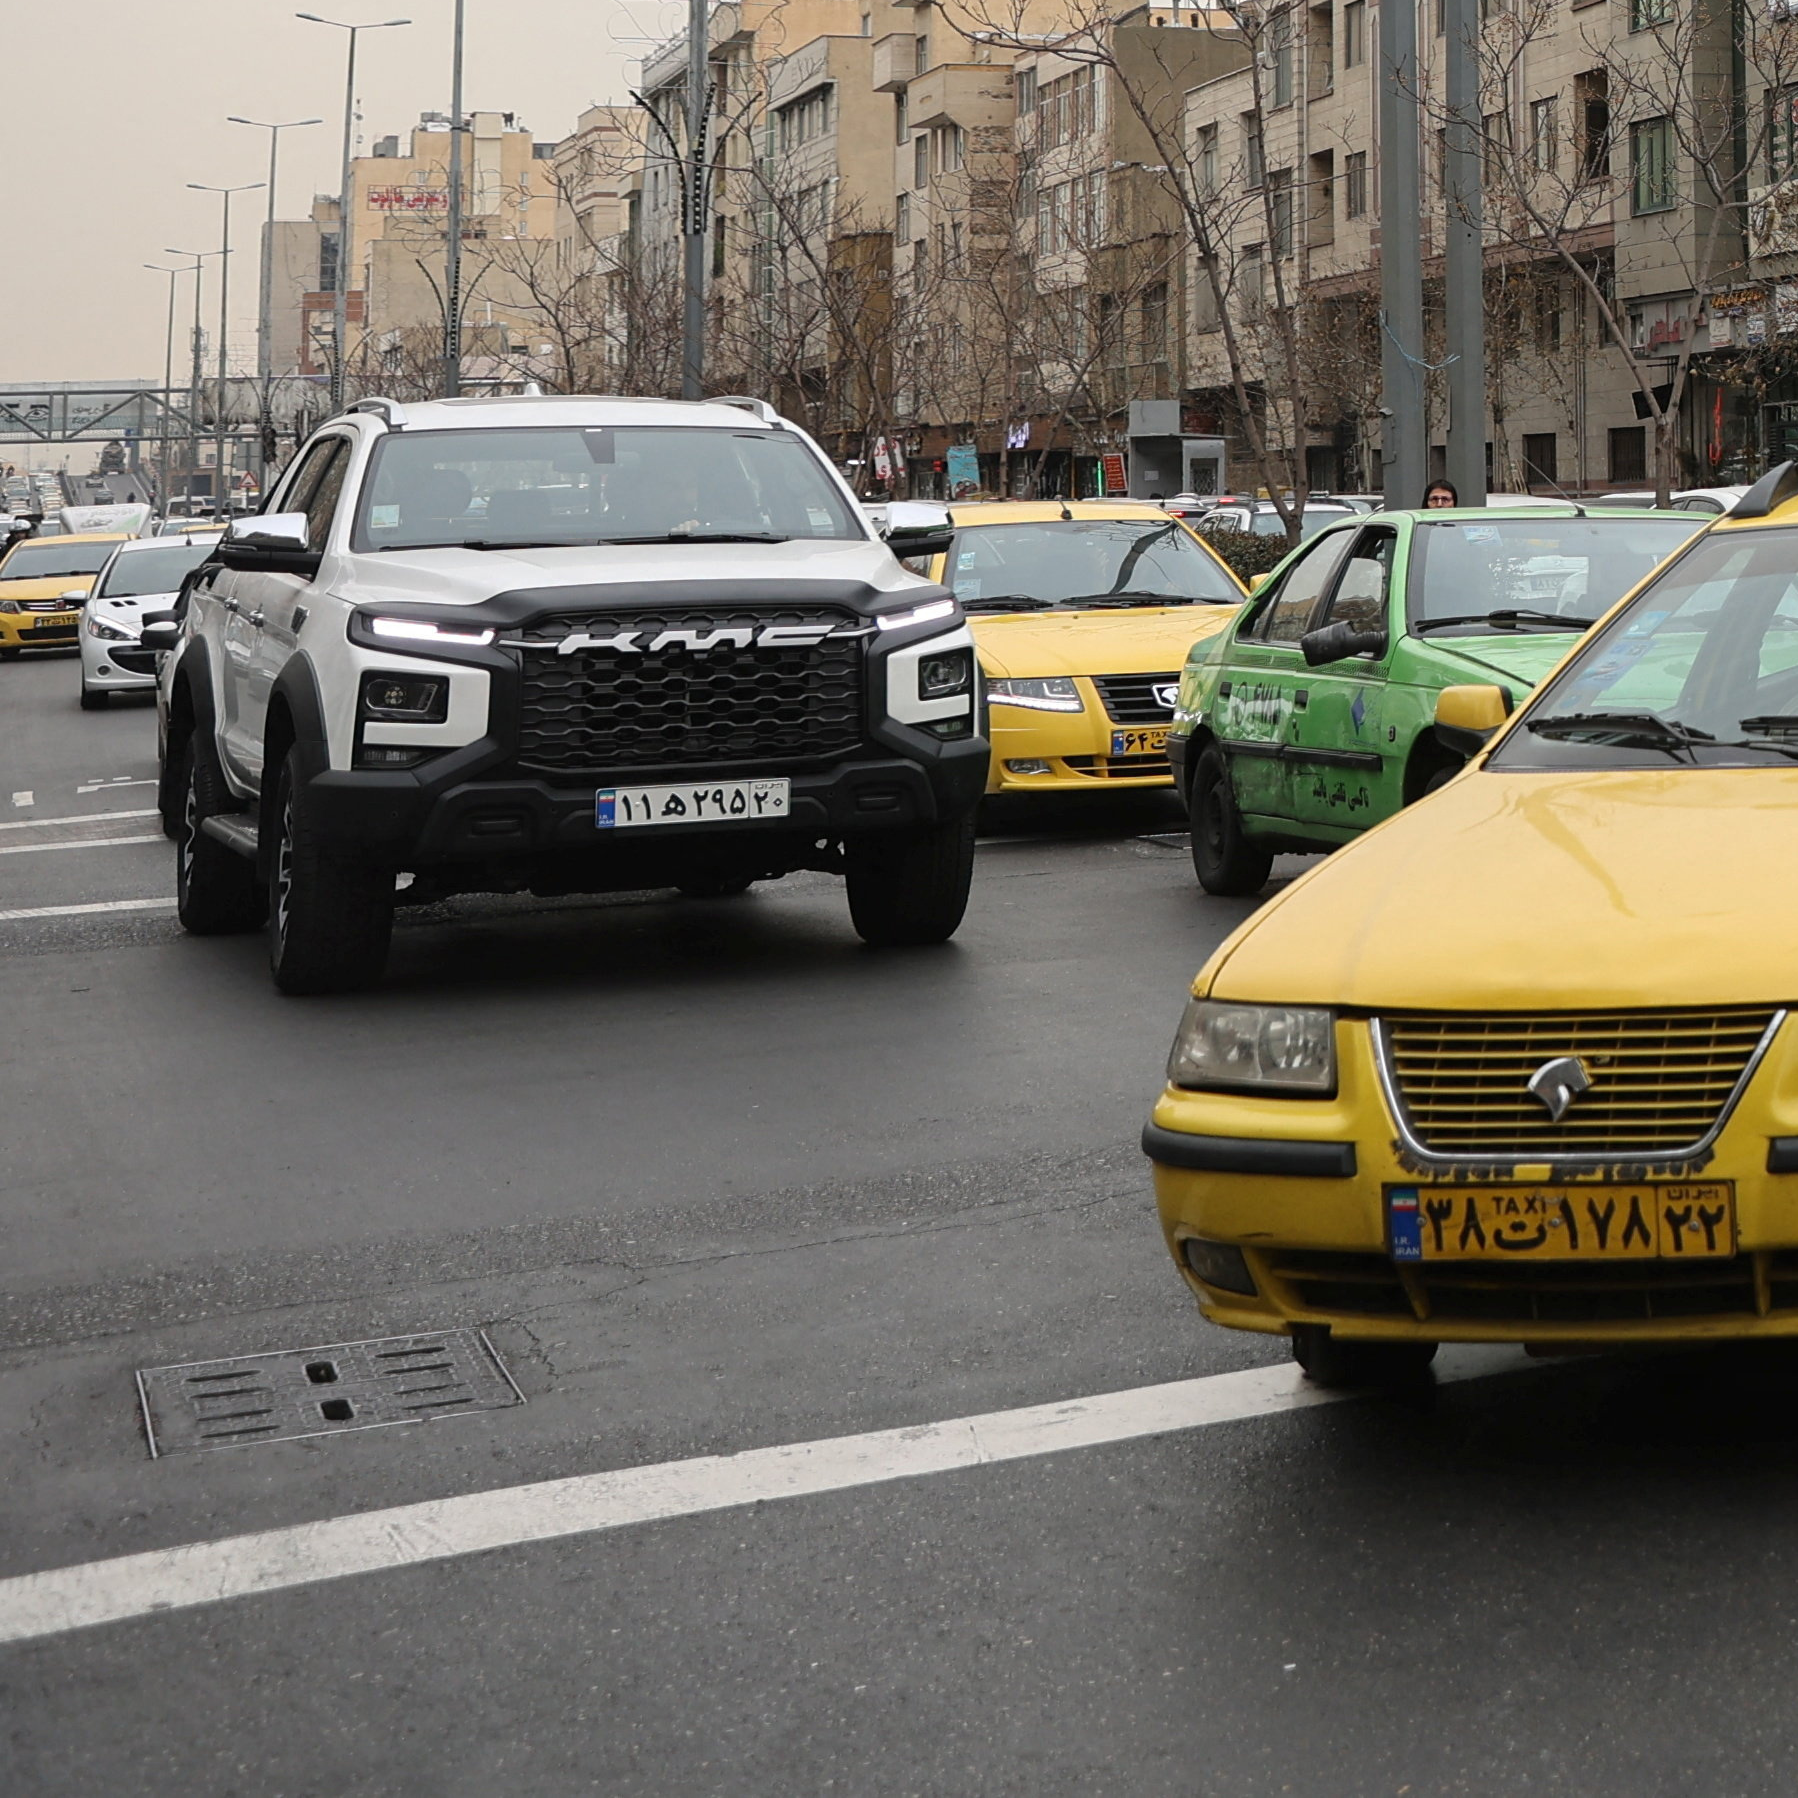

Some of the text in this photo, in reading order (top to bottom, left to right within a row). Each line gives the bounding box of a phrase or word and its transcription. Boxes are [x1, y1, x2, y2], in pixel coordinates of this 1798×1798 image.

[557, 624, 836, 654] KMC
[754, 791, 783, 814] ۲۰
[1665, 1204, 1725, 1252] ۲۲
[1395, 1247, 1420, 1257] IRAN
